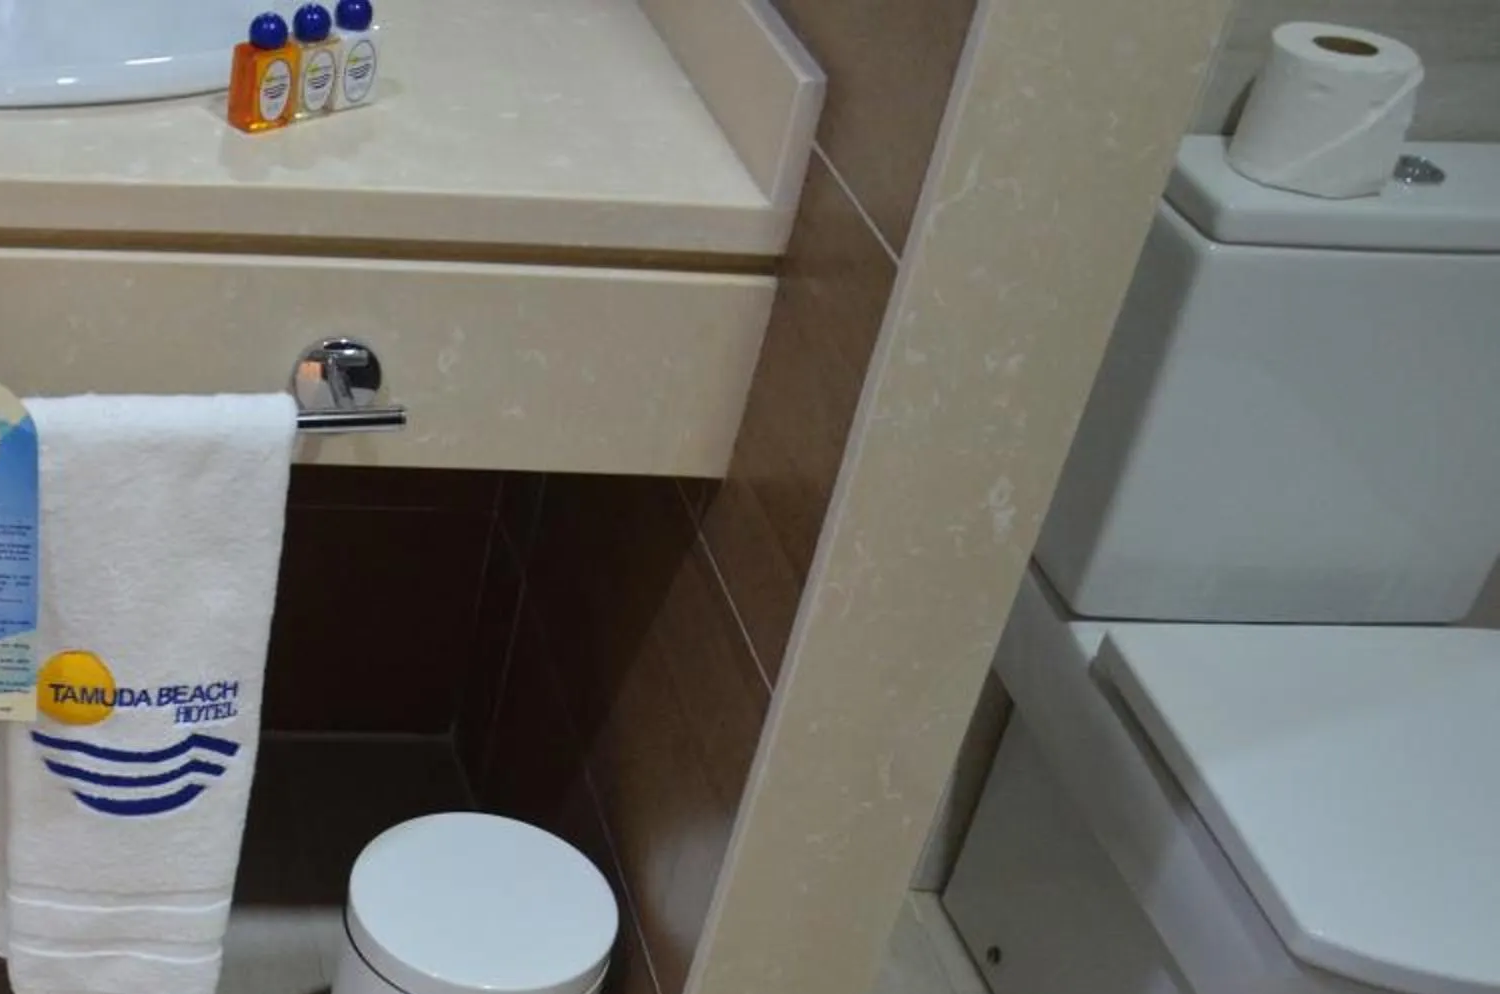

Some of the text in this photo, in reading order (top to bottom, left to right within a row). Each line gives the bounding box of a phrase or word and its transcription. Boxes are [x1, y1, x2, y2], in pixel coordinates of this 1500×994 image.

[48, 683, 152, 707] TAMUDA
[156, 680, 239, 707] BEACH
[174, 702, 238, 724] HOTEL
